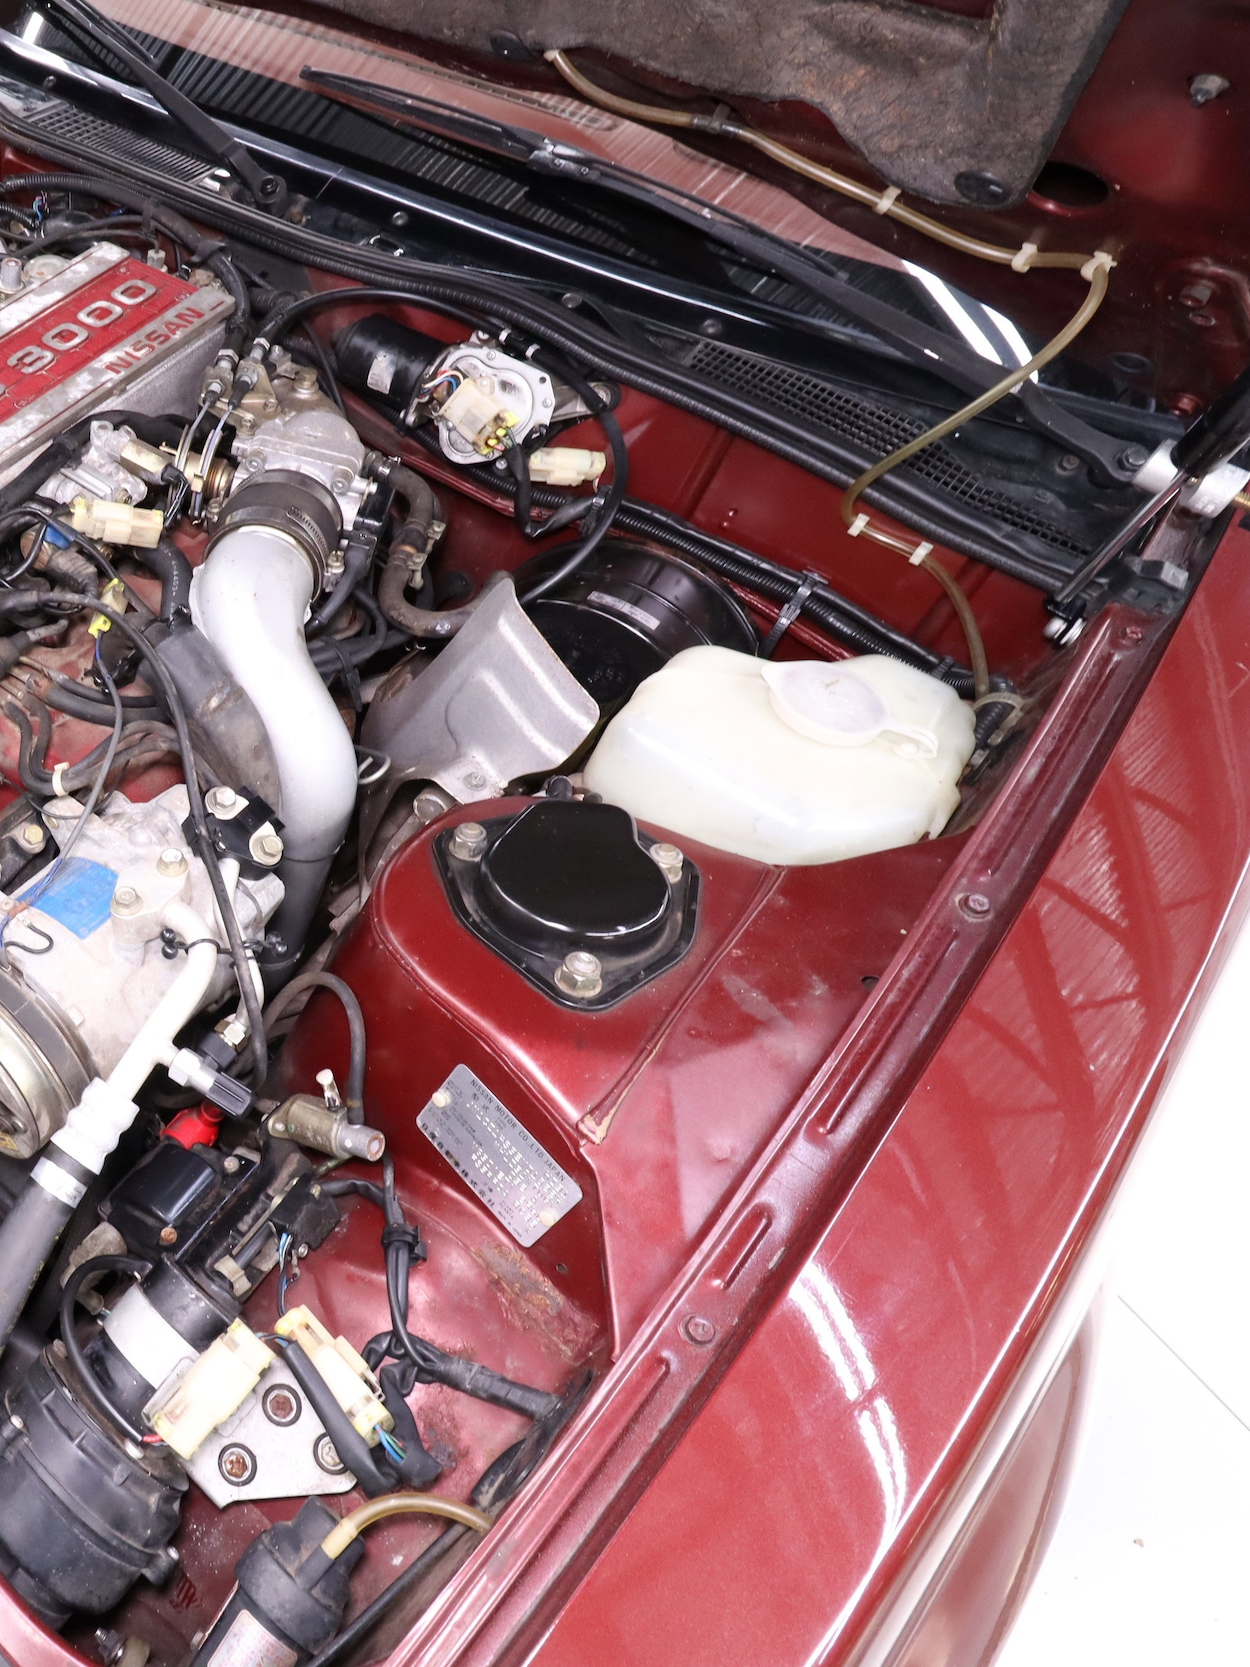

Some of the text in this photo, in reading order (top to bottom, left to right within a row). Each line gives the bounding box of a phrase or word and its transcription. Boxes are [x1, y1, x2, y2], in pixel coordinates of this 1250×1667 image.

[7, 279, 157, 374] 3000
[102, 306, 205, 375] NISSAN
[470, 1079, 493, 1104] NISSAN
[494, 1105, 517, 1129] MOTOR
